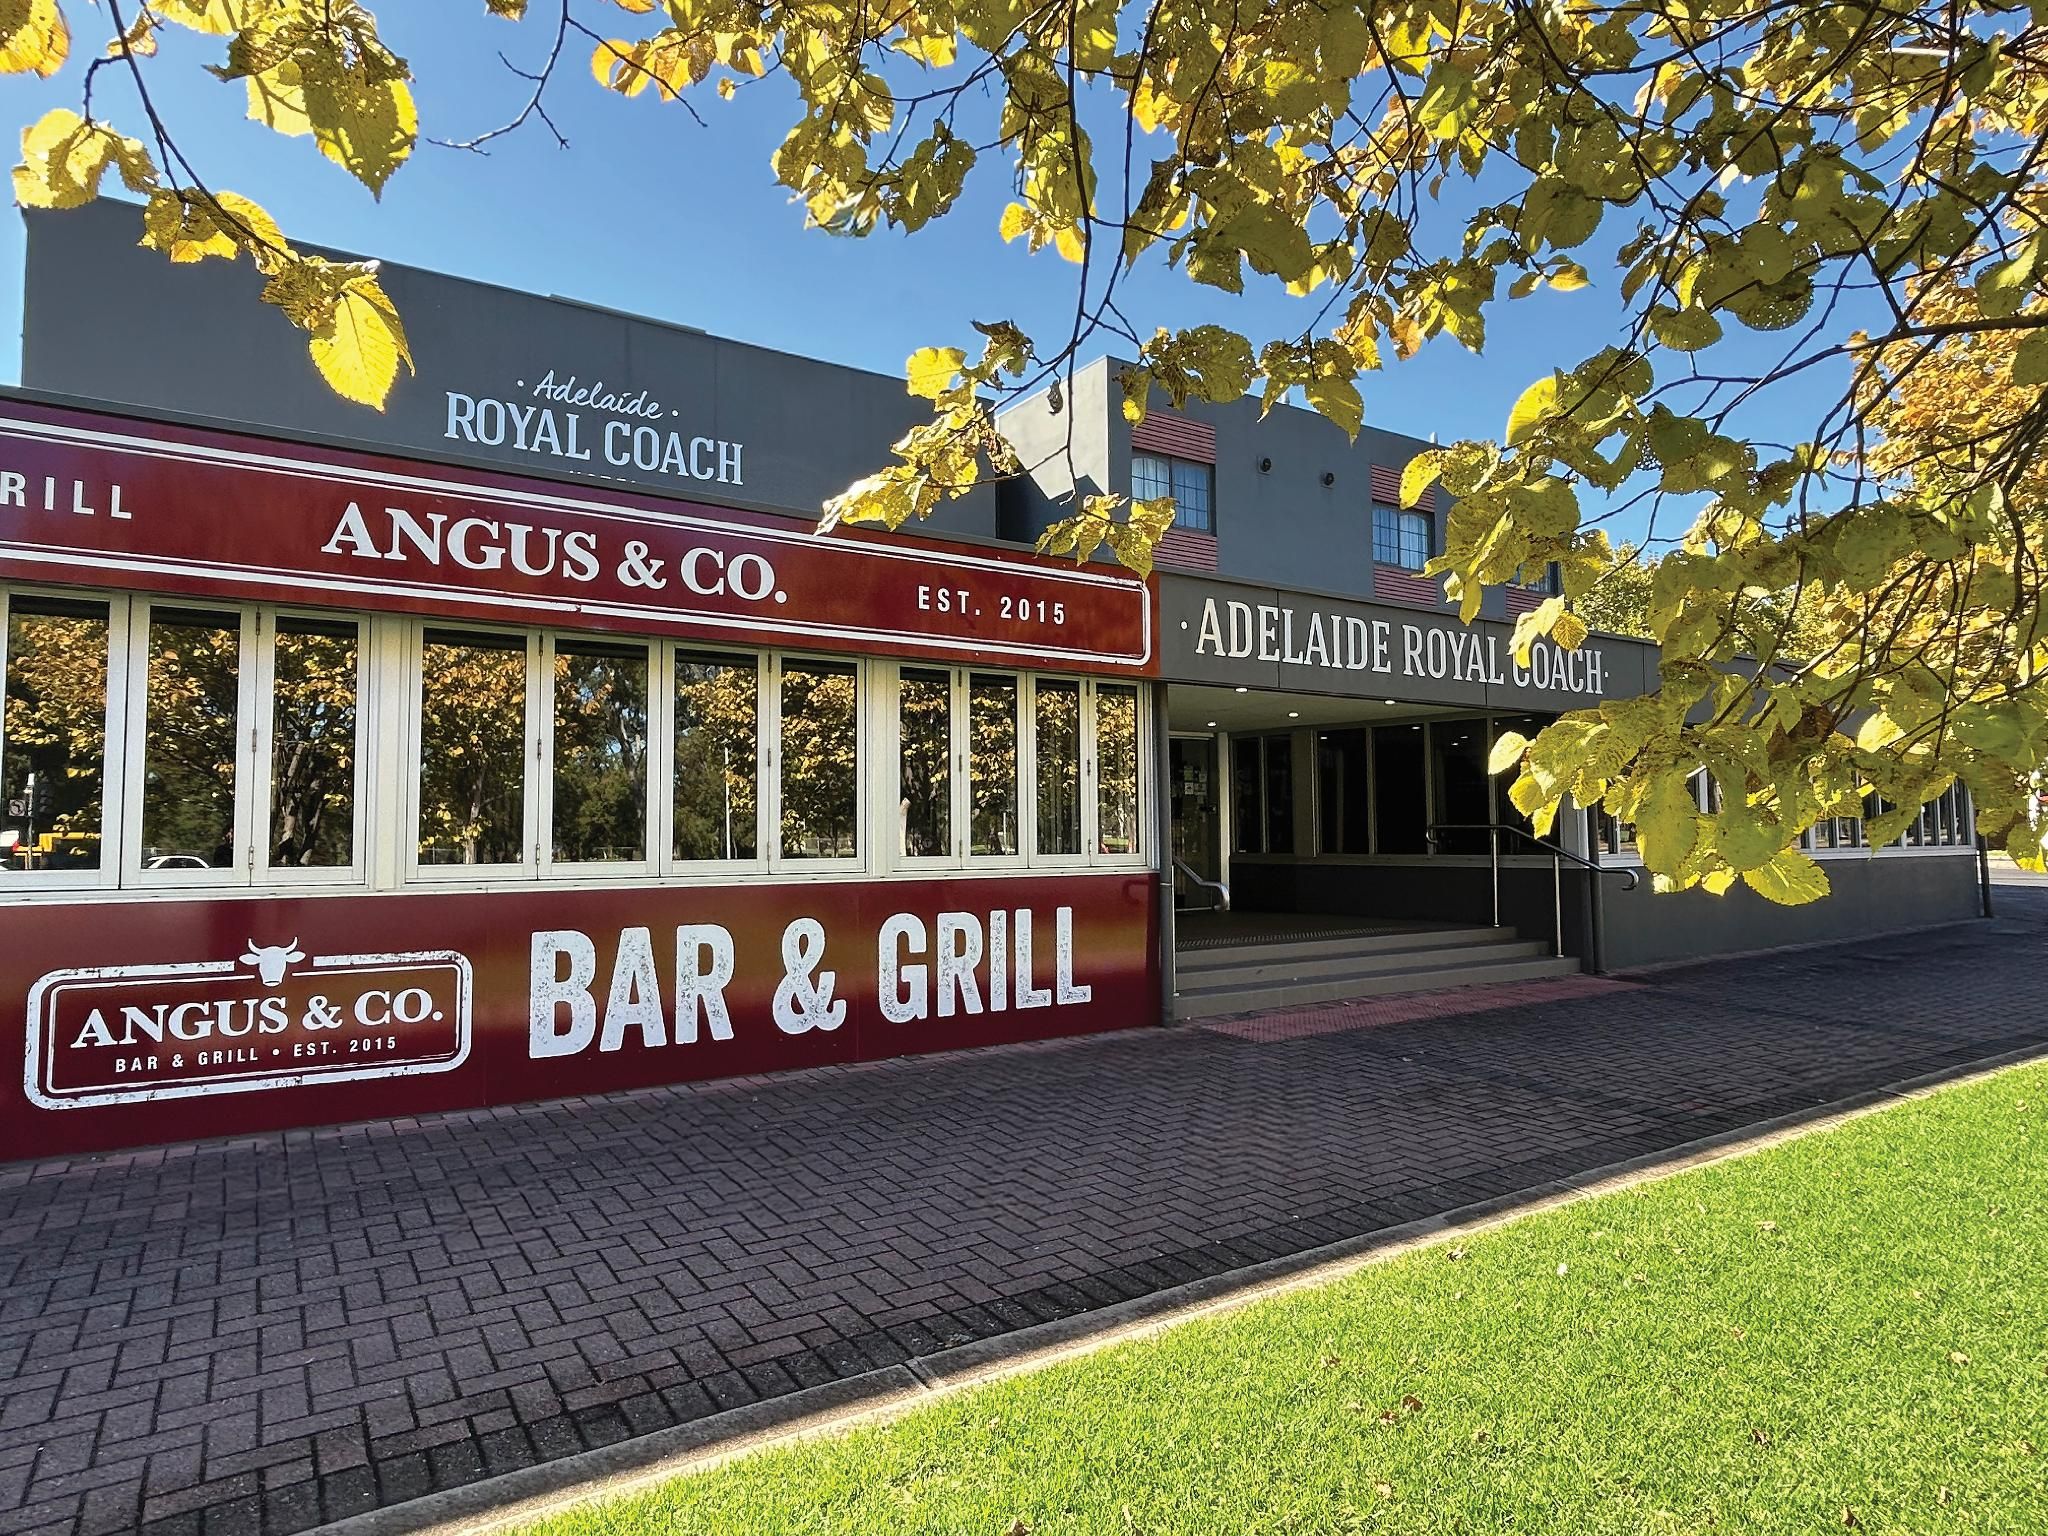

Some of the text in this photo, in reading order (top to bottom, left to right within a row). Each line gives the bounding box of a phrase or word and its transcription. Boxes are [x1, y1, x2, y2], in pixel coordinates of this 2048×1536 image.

[533, 370, 663, 419] Adelaide
[444, 391, 744, 485] ROYAL COACH
[0, 471, 132, 519] RILL
[321, 502, 788, 604] ANGUS & CO.
[918, 585, 1065, 625] EST. 2015
[1195, 597, 1392, 674] ADELAIDE
[1402, 624, 1504, 685] ROYAL
[529, 906, 1092, 1059] BAR & GRILL
[70, 988, 444, 1049] ANGUS & CO.
[115, 1036, 397, 1073] BAR & GRILL EST. 2015
